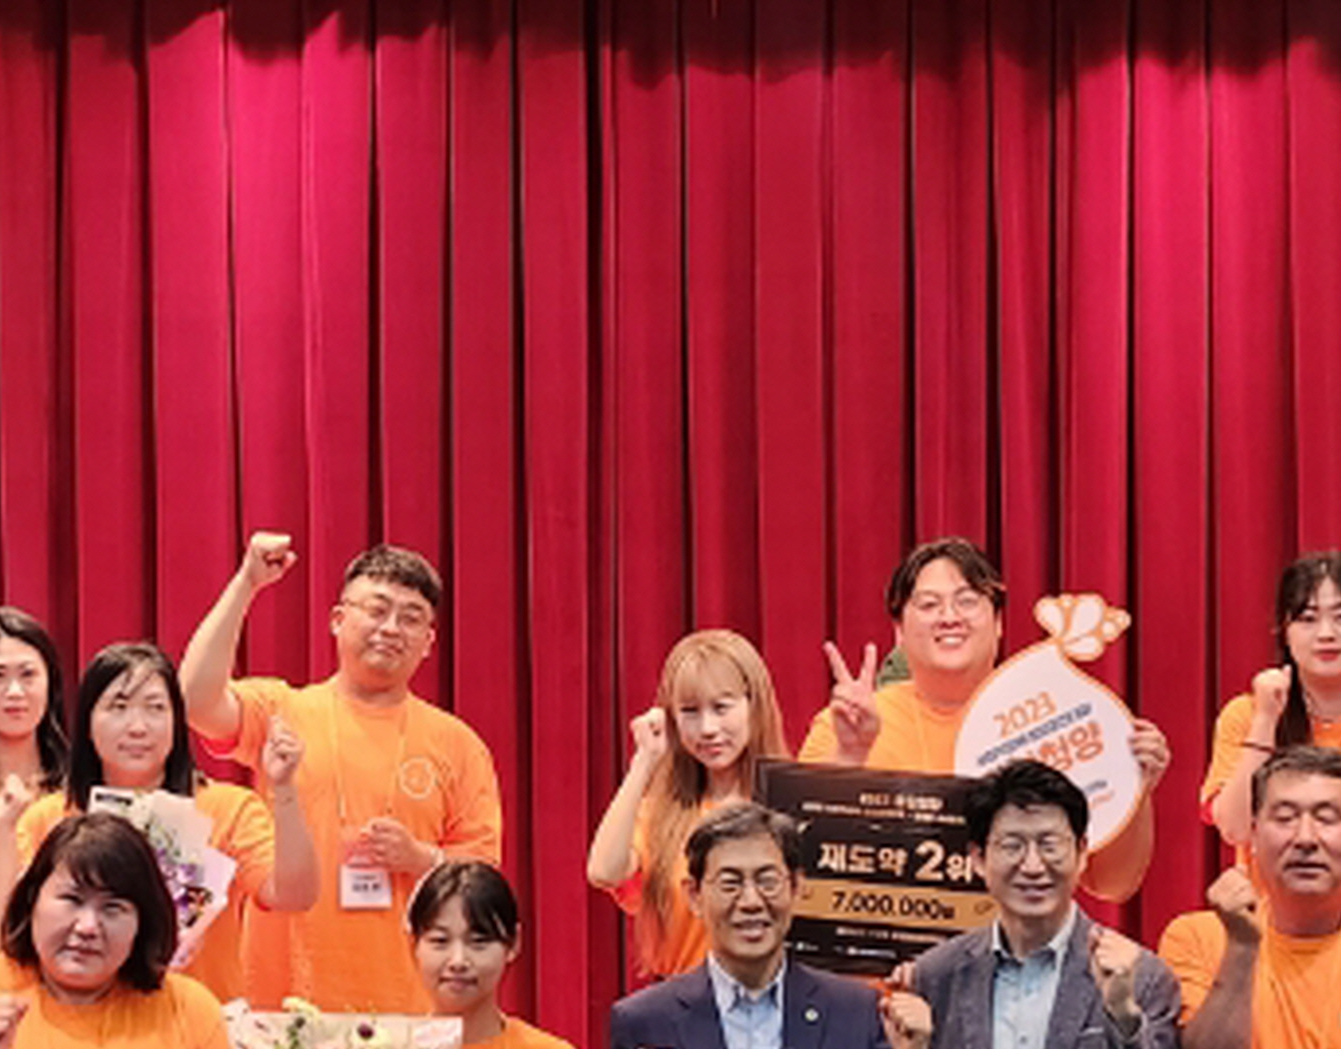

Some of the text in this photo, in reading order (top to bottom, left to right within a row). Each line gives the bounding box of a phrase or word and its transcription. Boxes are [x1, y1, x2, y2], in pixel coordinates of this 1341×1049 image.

[992, 691, 1057, 740] 2023
[817, 839, 973, 883] 재도약 2위
